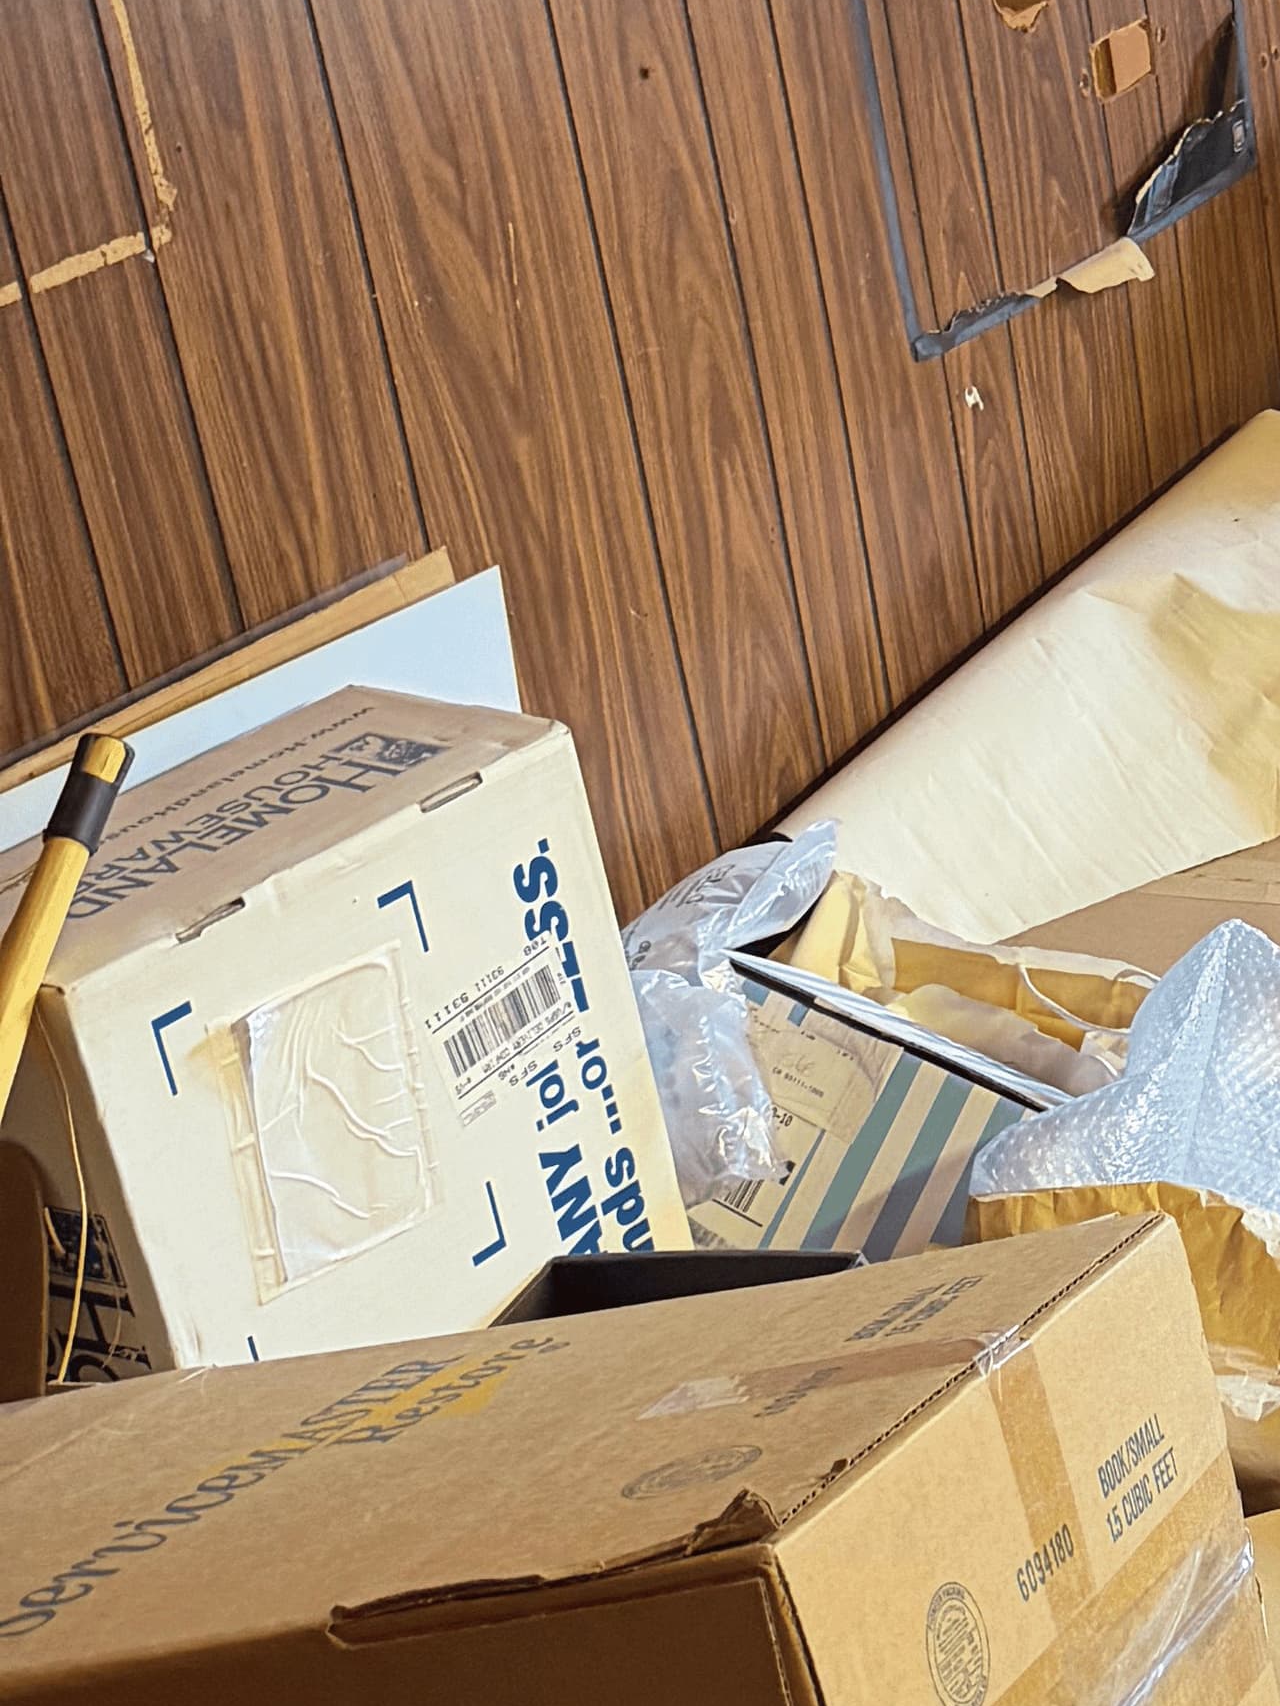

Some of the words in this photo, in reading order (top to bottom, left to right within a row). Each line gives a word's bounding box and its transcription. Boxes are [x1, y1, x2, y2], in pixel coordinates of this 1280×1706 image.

[66, 758, 402, 921] HOMELAND
[325, 1335, 555, 1445] Restore
[1097, 1413, 1166, 1499] BOOK/SMALL
[1122, 1481, 1155, 1527] CUBIC
[1151, 1446, 1180, 1491] FEET
[1016, 1523, 1076, 1604] 6094180
